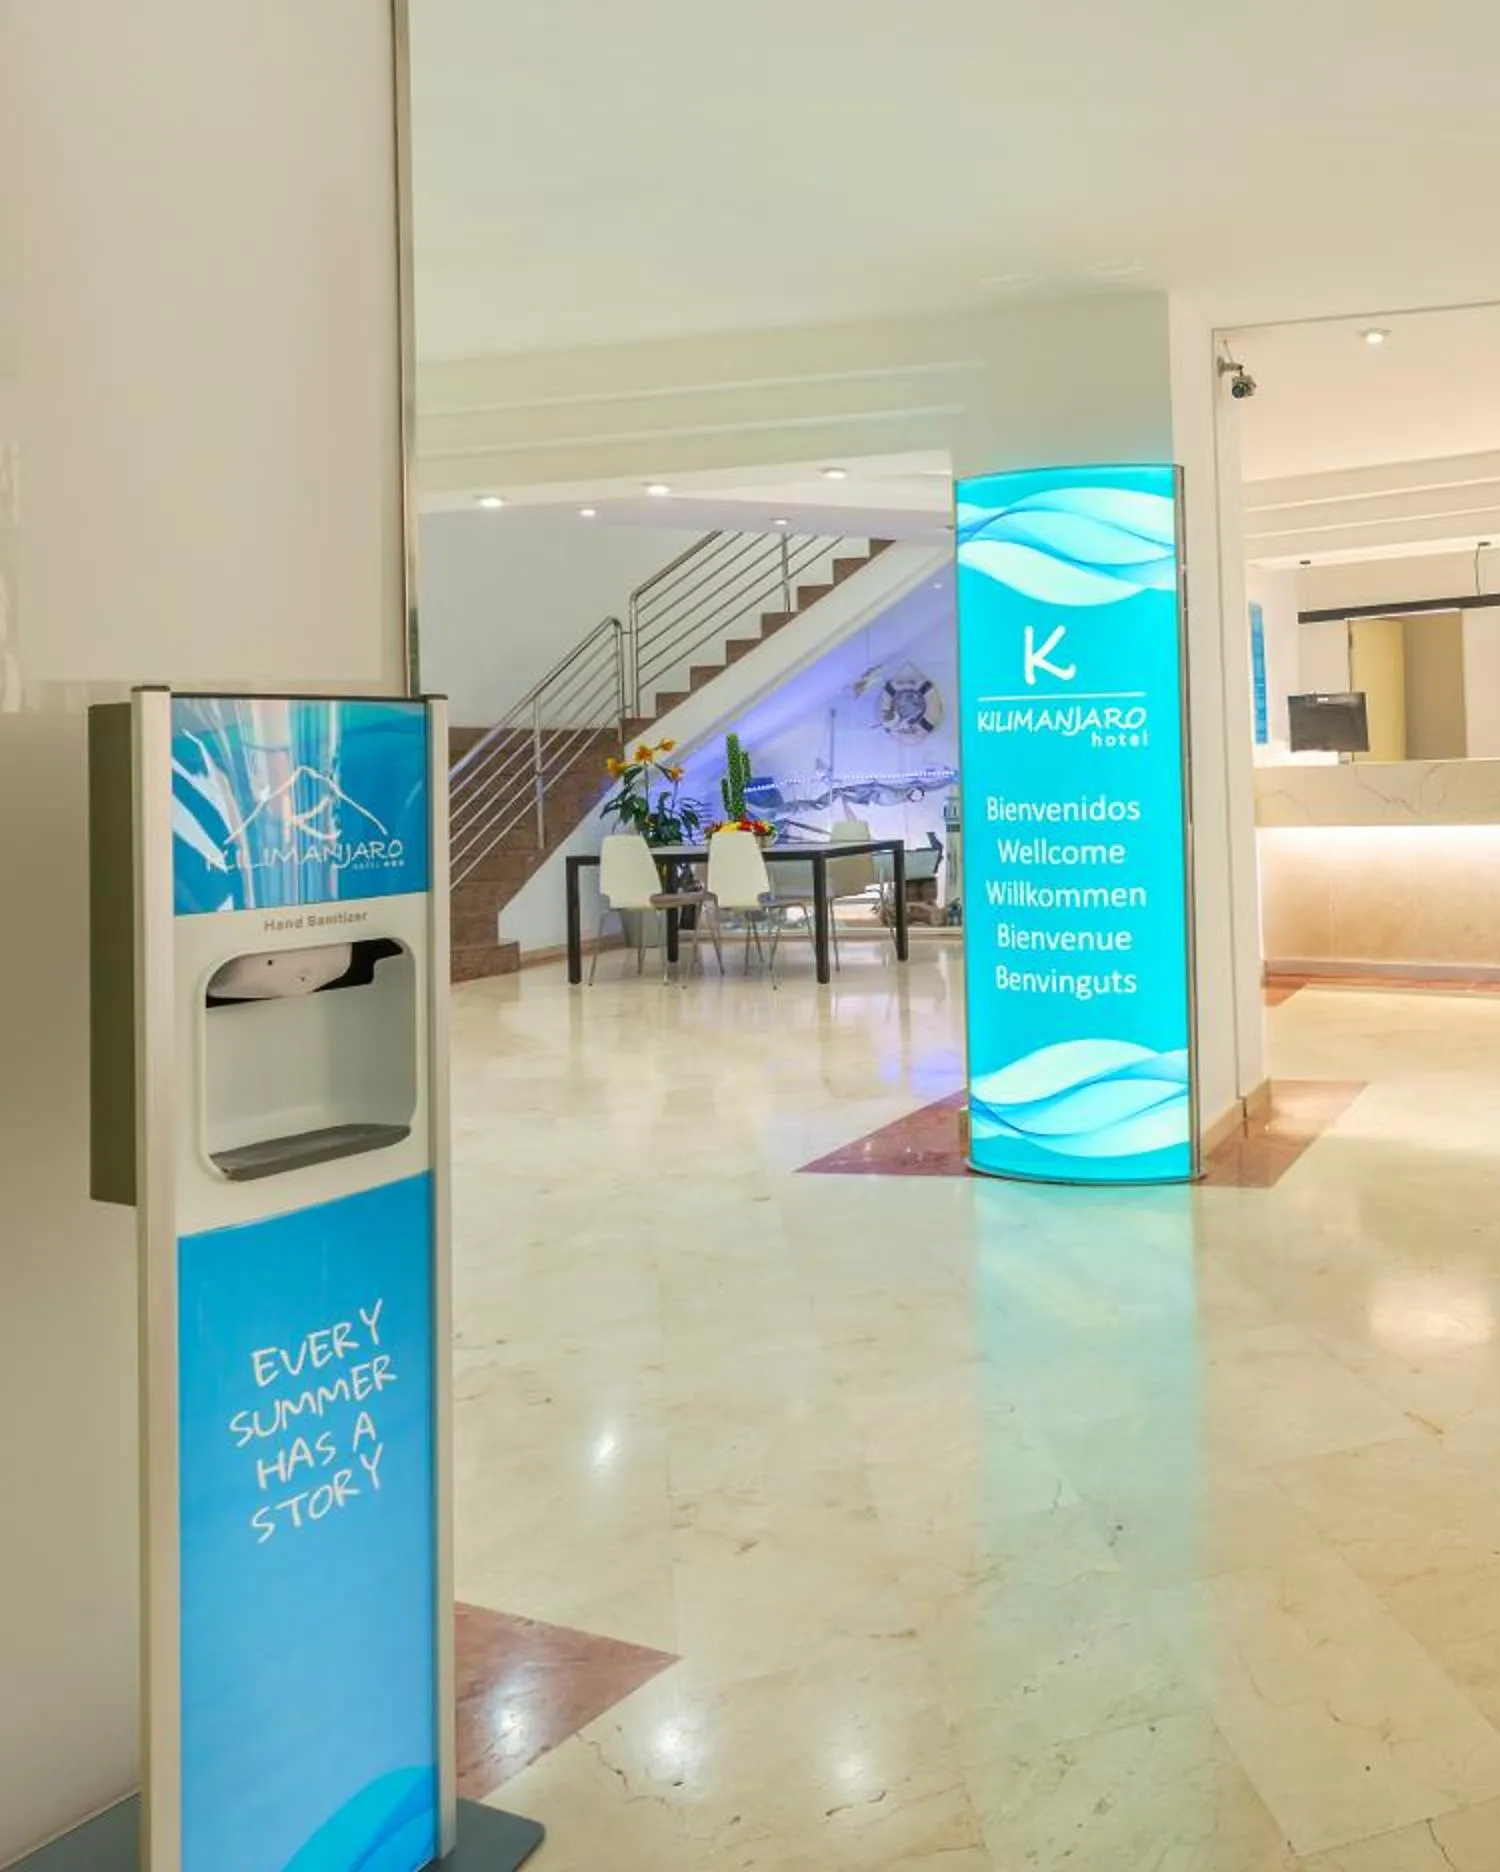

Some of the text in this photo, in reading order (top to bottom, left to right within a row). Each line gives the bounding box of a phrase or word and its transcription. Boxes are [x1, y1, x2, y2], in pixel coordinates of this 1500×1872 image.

[1024, 624, 1077, 686] K
[977, 704, 1148, 737] KILIMANJARO
[1091, 730, 1149, 747] hotel
[986, 795, 1141, 822] Bienvenidos
[997, 838, 1126, 865] Wellcome
[985, 879, 1148, 908] Willkommen
[263, 911, 368, 932] Hand Sanitizer
[996, 922, 1133, 951] Bienvenue
[995, 964, 1138, 1000] Benvinguts
[252, 1298, 383, 1388] EVERY
[229, 1354, 398, 1448] SUMMER
[256, 1410, 377, 1491] HAS A
[251, 1442, 384, 1544] STORY
